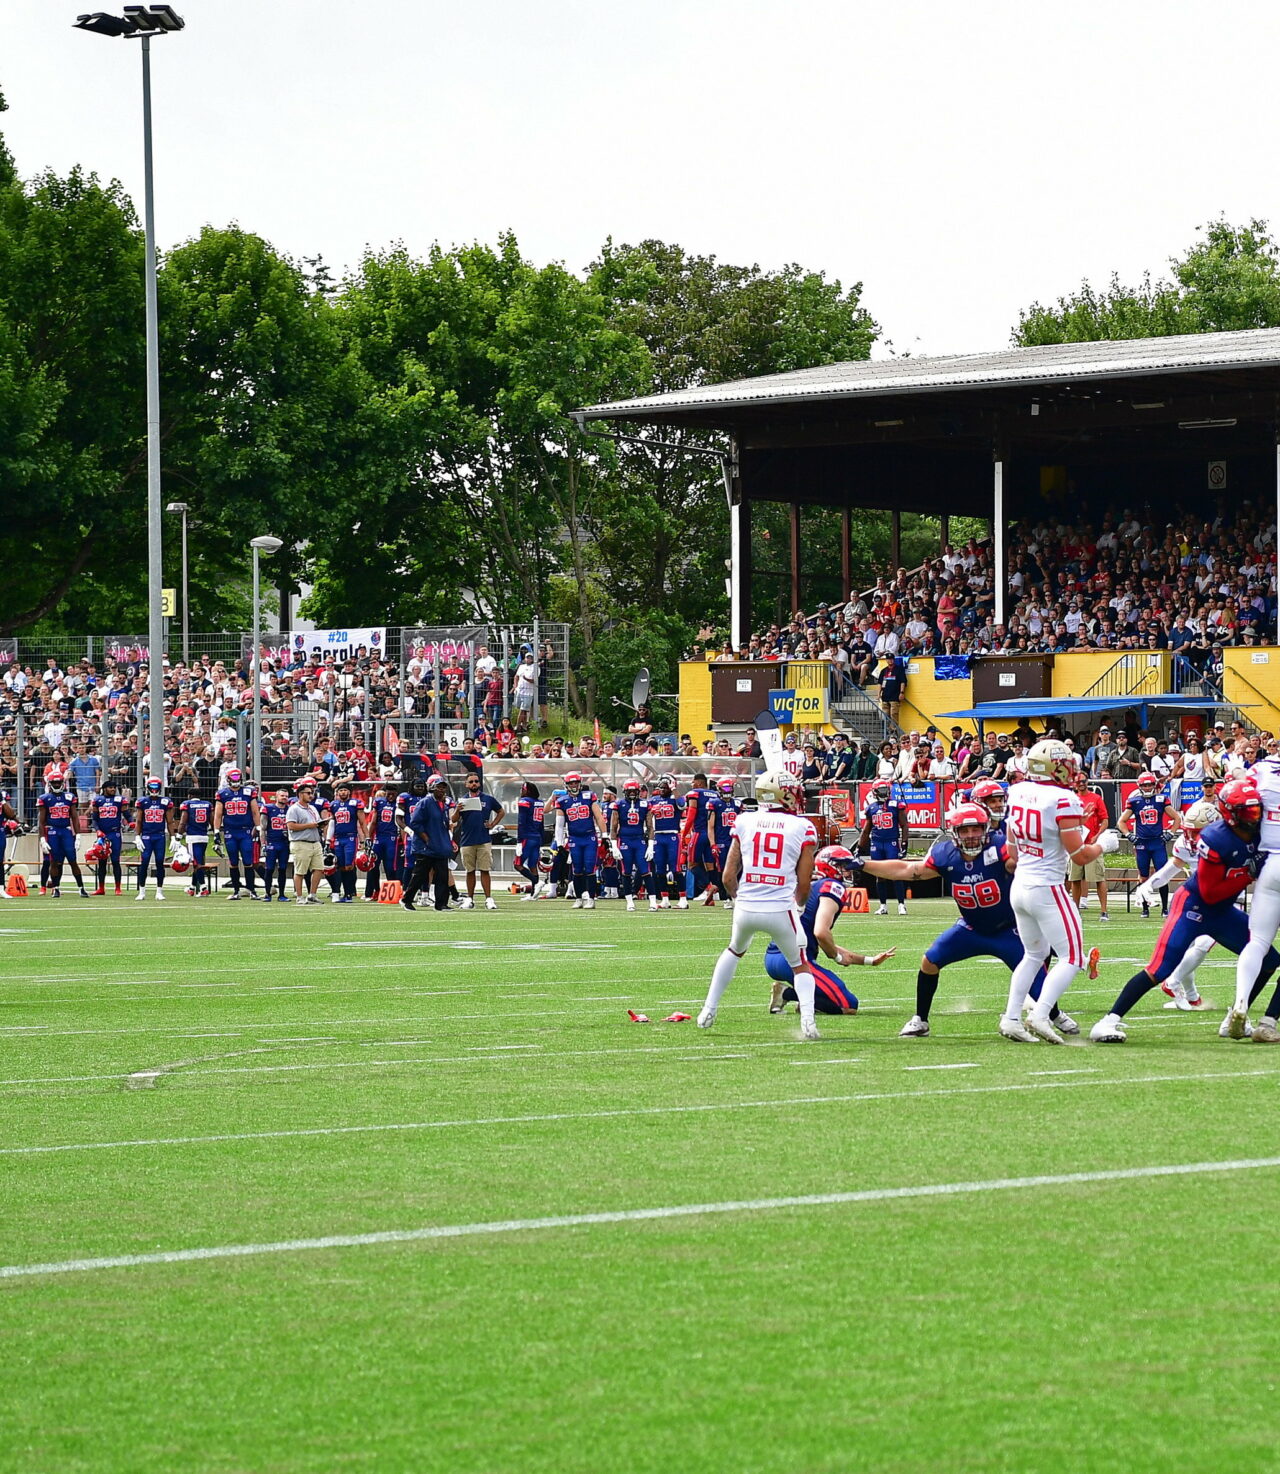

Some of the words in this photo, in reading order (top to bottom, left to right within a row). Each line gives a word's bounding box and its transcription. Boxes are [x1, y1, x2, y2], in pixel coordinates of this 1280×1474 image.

[327, 631, 348, 643] #20
[773, 697, 820, 712] VICTOR
[450, 737, 458, 747] 8
[353, 759, 367, 771] 32
[784, 761, 797, 774] 10
[195, 808, 207, 823] 5
[335, 810, 350, 823] 21
[566, 805, 590, 821] 59
[627, 812, 640, 825] 3
[1139, 809, 1158, 826] 13
[1011, 805, 1043, 843] 30
[752, 832, 784, 869] 19
[380, 882, 396, 901] 50
